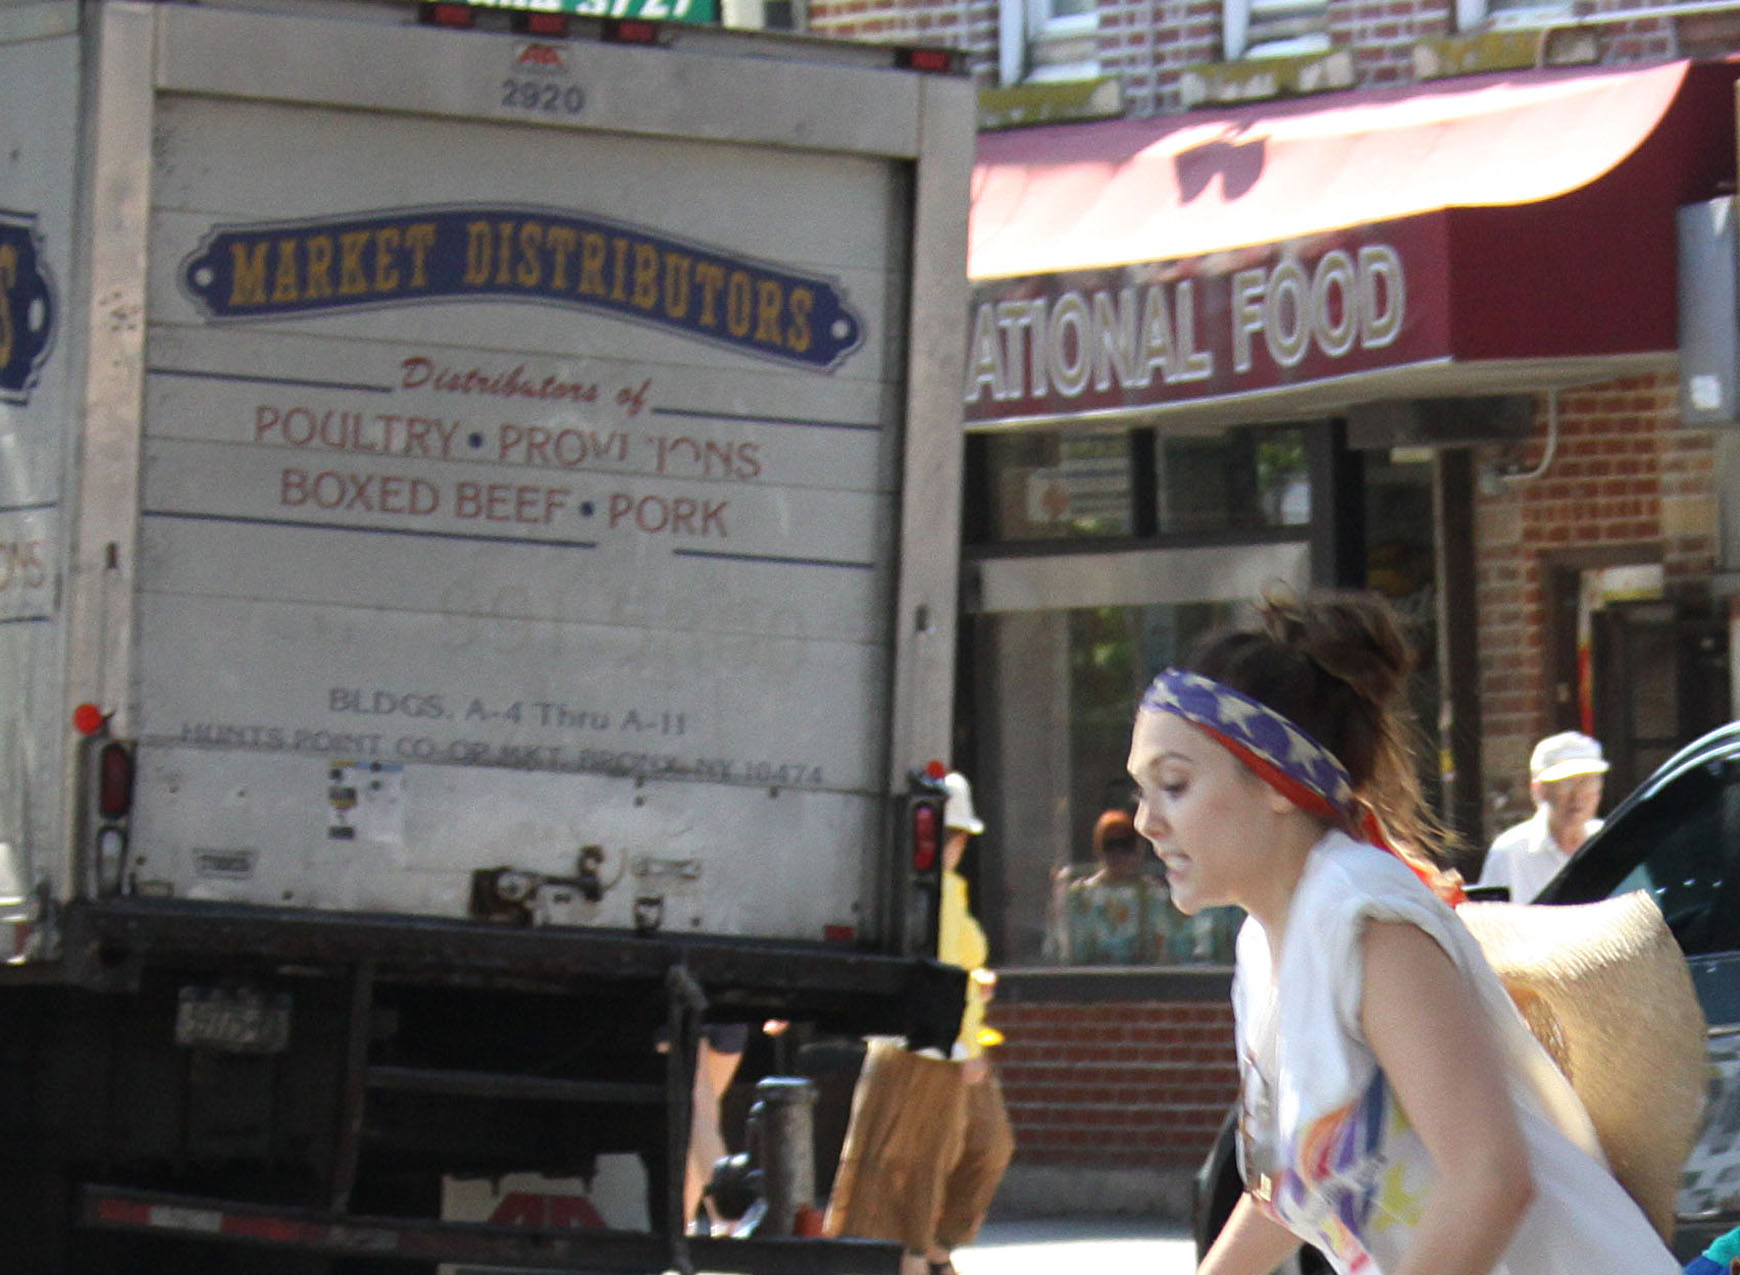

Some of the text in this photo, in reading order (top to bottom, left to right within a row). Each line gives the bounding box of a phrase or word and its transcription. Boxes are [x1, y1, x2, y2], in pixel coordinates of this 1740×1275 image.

[501, 79, 586, 114] 2920
[227, 221, 815, 356] MARKET DISTRIBUTORS
[1234, 244, 1405, 372] FOOD
[402, 357, 652, 416] Distributors of
[253, 405, 761, 481] POULTRY PROVIIONS
[281, 468, 728, 537] BOXED BEEF PORK
[181, 722, 283, 750] HUNTS
[296, 730, 384, 756] POINT
[329, 687, 687, 736] BLDGS. A-4 Thru A-11
